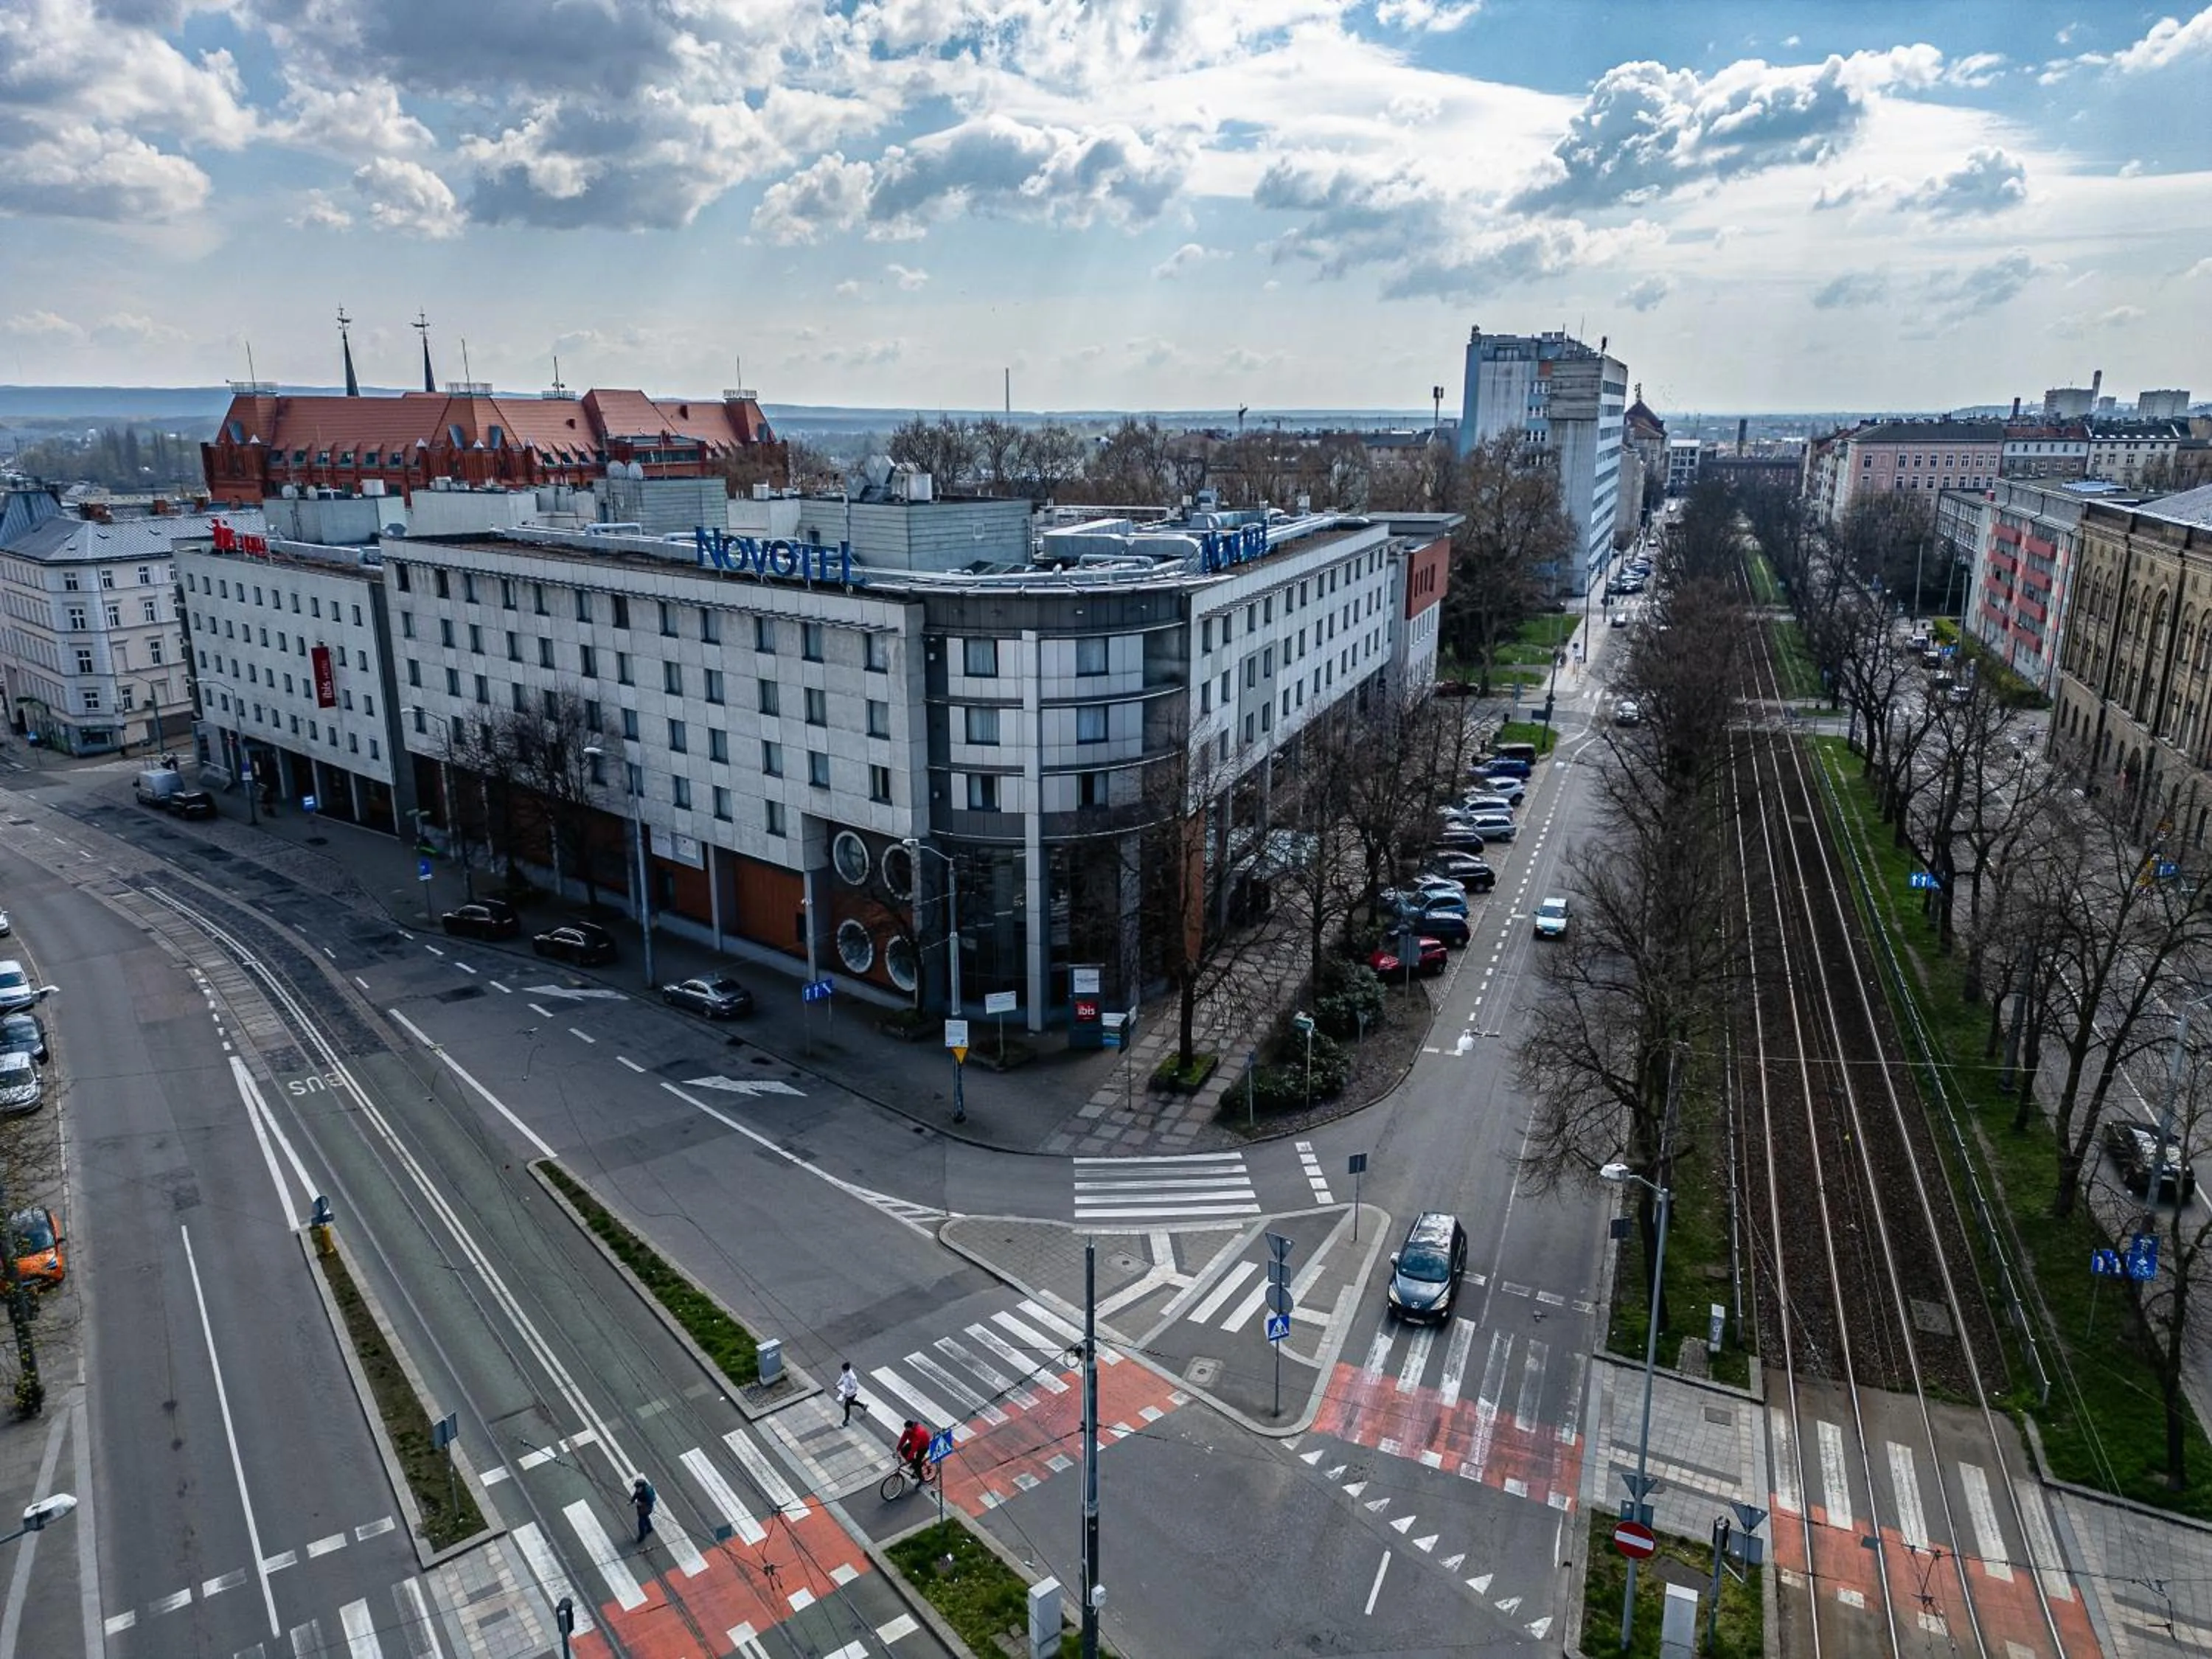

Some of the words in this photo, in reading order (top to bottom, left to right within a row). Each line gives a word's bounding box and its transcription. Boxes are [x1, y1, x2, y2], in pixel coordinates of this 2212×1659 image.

[695, 526, 866, 587] NOVOTEL
[1077, 1004, 1096, 1015] ibis
[288, 1073, 344, 1096] BUS
